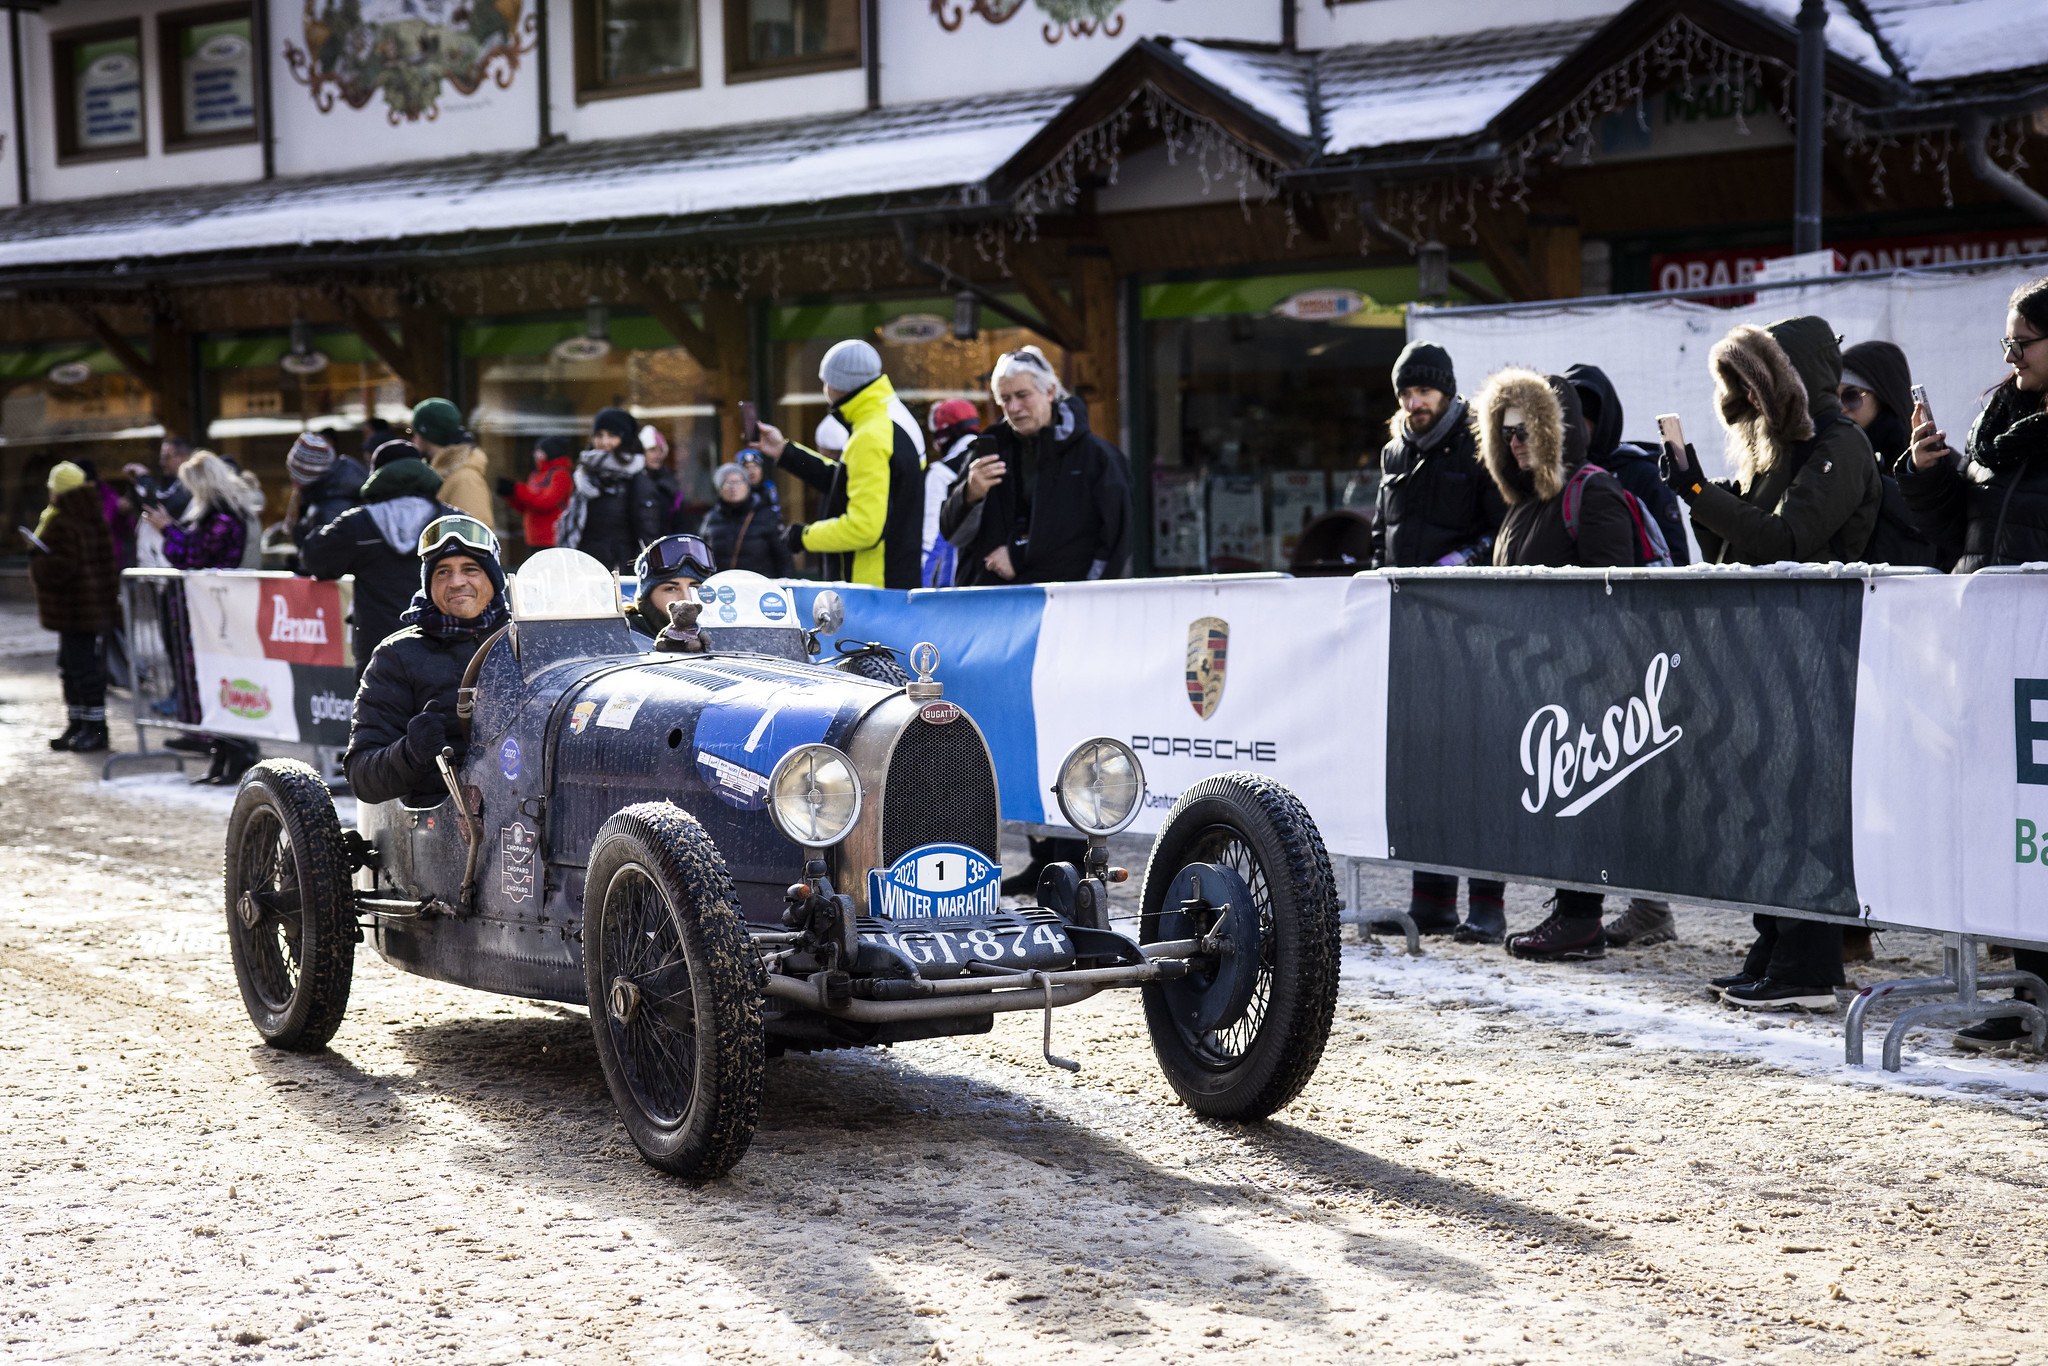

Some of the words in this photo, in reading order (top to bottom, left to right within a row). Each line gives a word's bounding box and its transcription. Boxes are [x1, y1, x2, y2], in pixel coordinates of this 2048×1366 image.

[925, 709, 956, 719] BUGATTI
[1519, 651, 1683, 818] Persol
[1132, 735, 1277, 762] PORSCHE
[506, 844, 530, 853] CHOPARD
[507, 865, 529, 874] CHOPARD
[894, 859, 916, 888] 2023
[935, 860, 945, 881] 1
[506, 885, 529, 894] CHOPARD
[877, 876, 932, 919] WINTER
